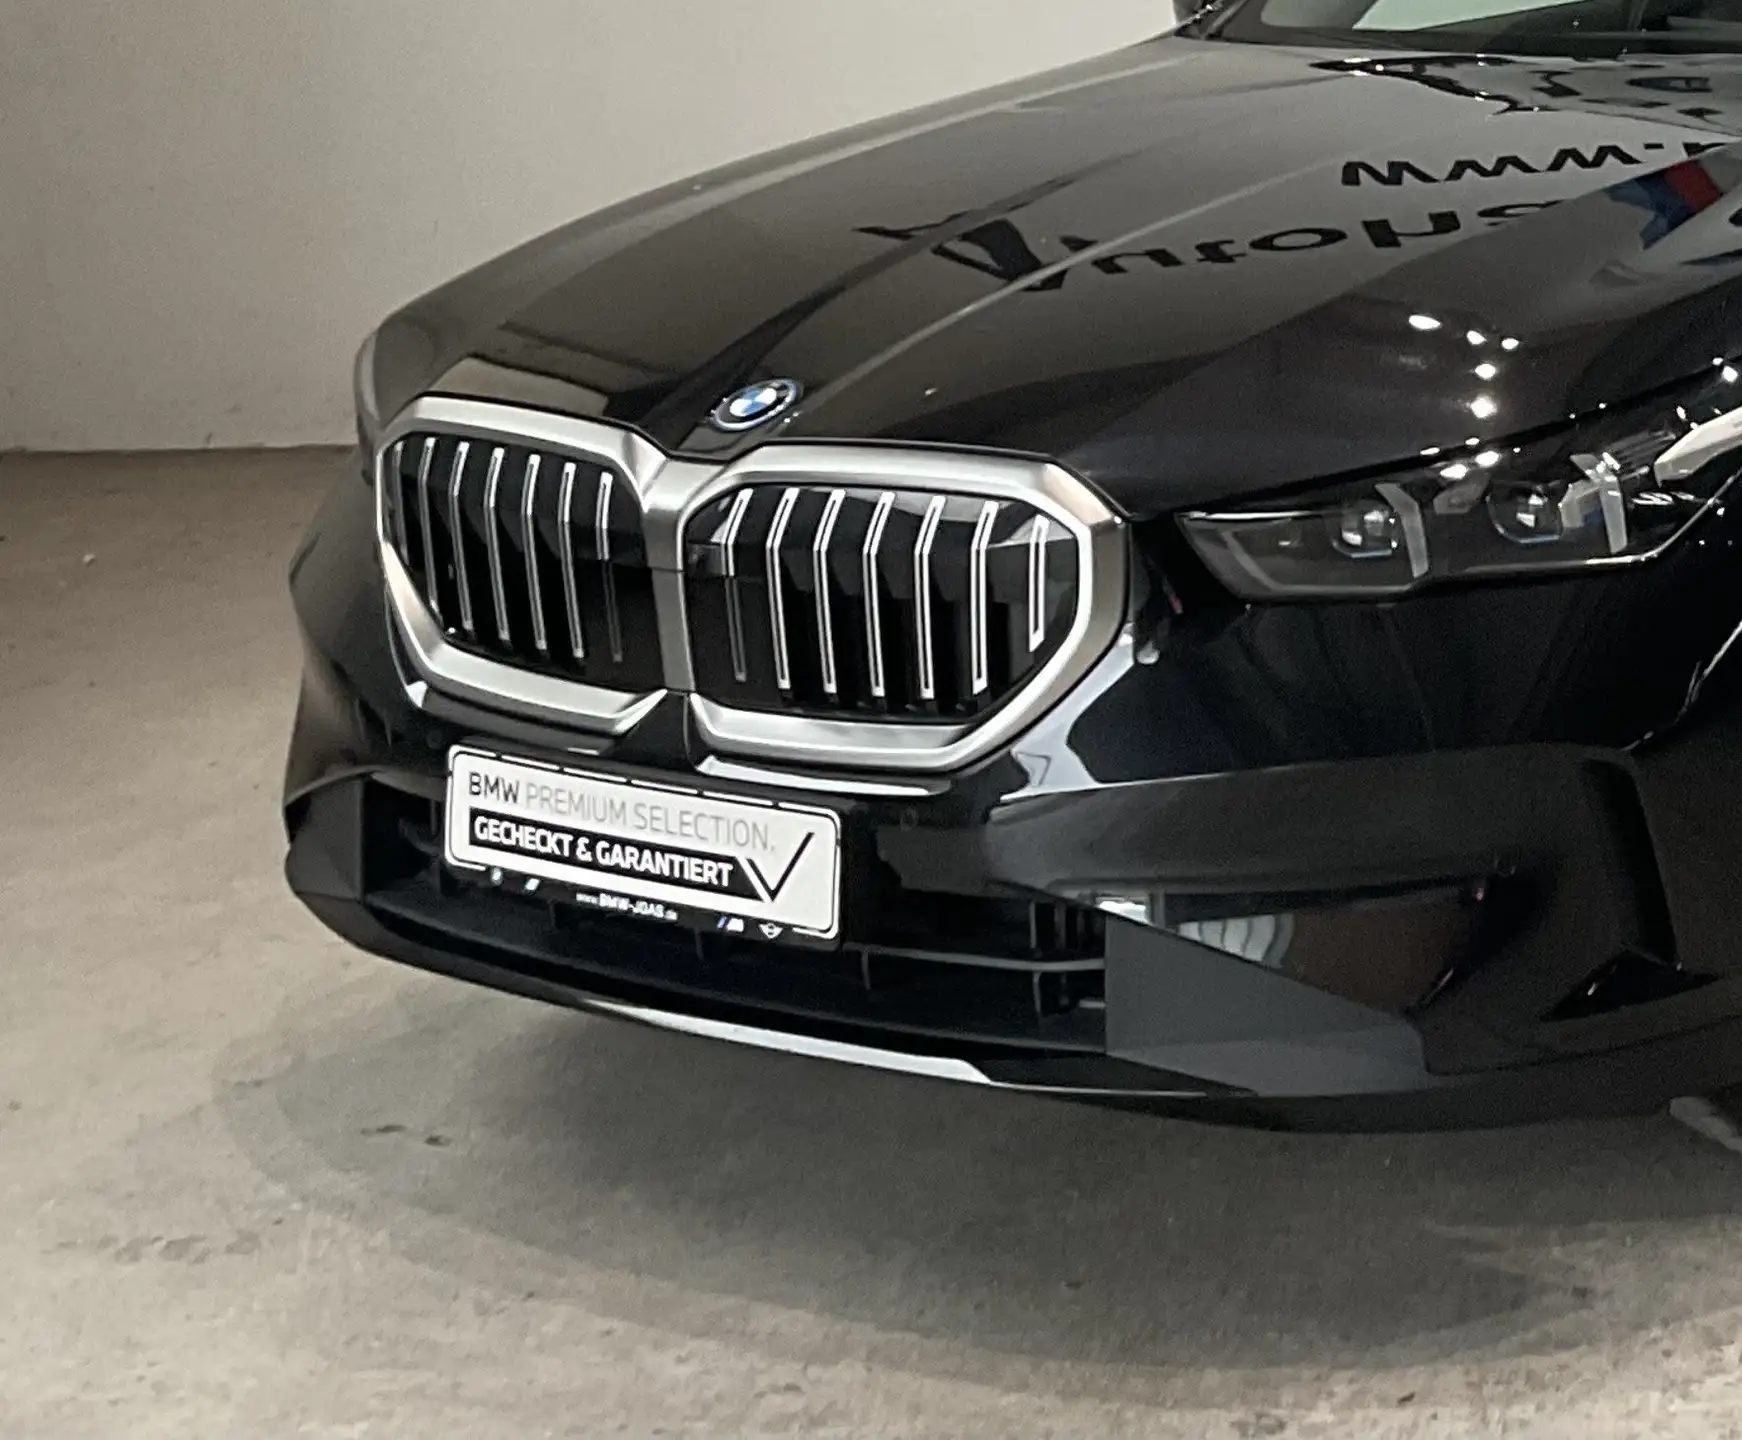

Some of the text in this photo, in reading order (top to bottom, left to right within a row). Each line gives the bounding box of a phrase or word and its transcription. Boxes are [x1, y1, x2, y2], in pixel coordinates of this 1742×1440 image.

[468, 771, 520, 805] BMW
[525, 782, 628, 828] PREMIUM
[474, 815, 734, 888] GECHECKT & GARANTIERT
